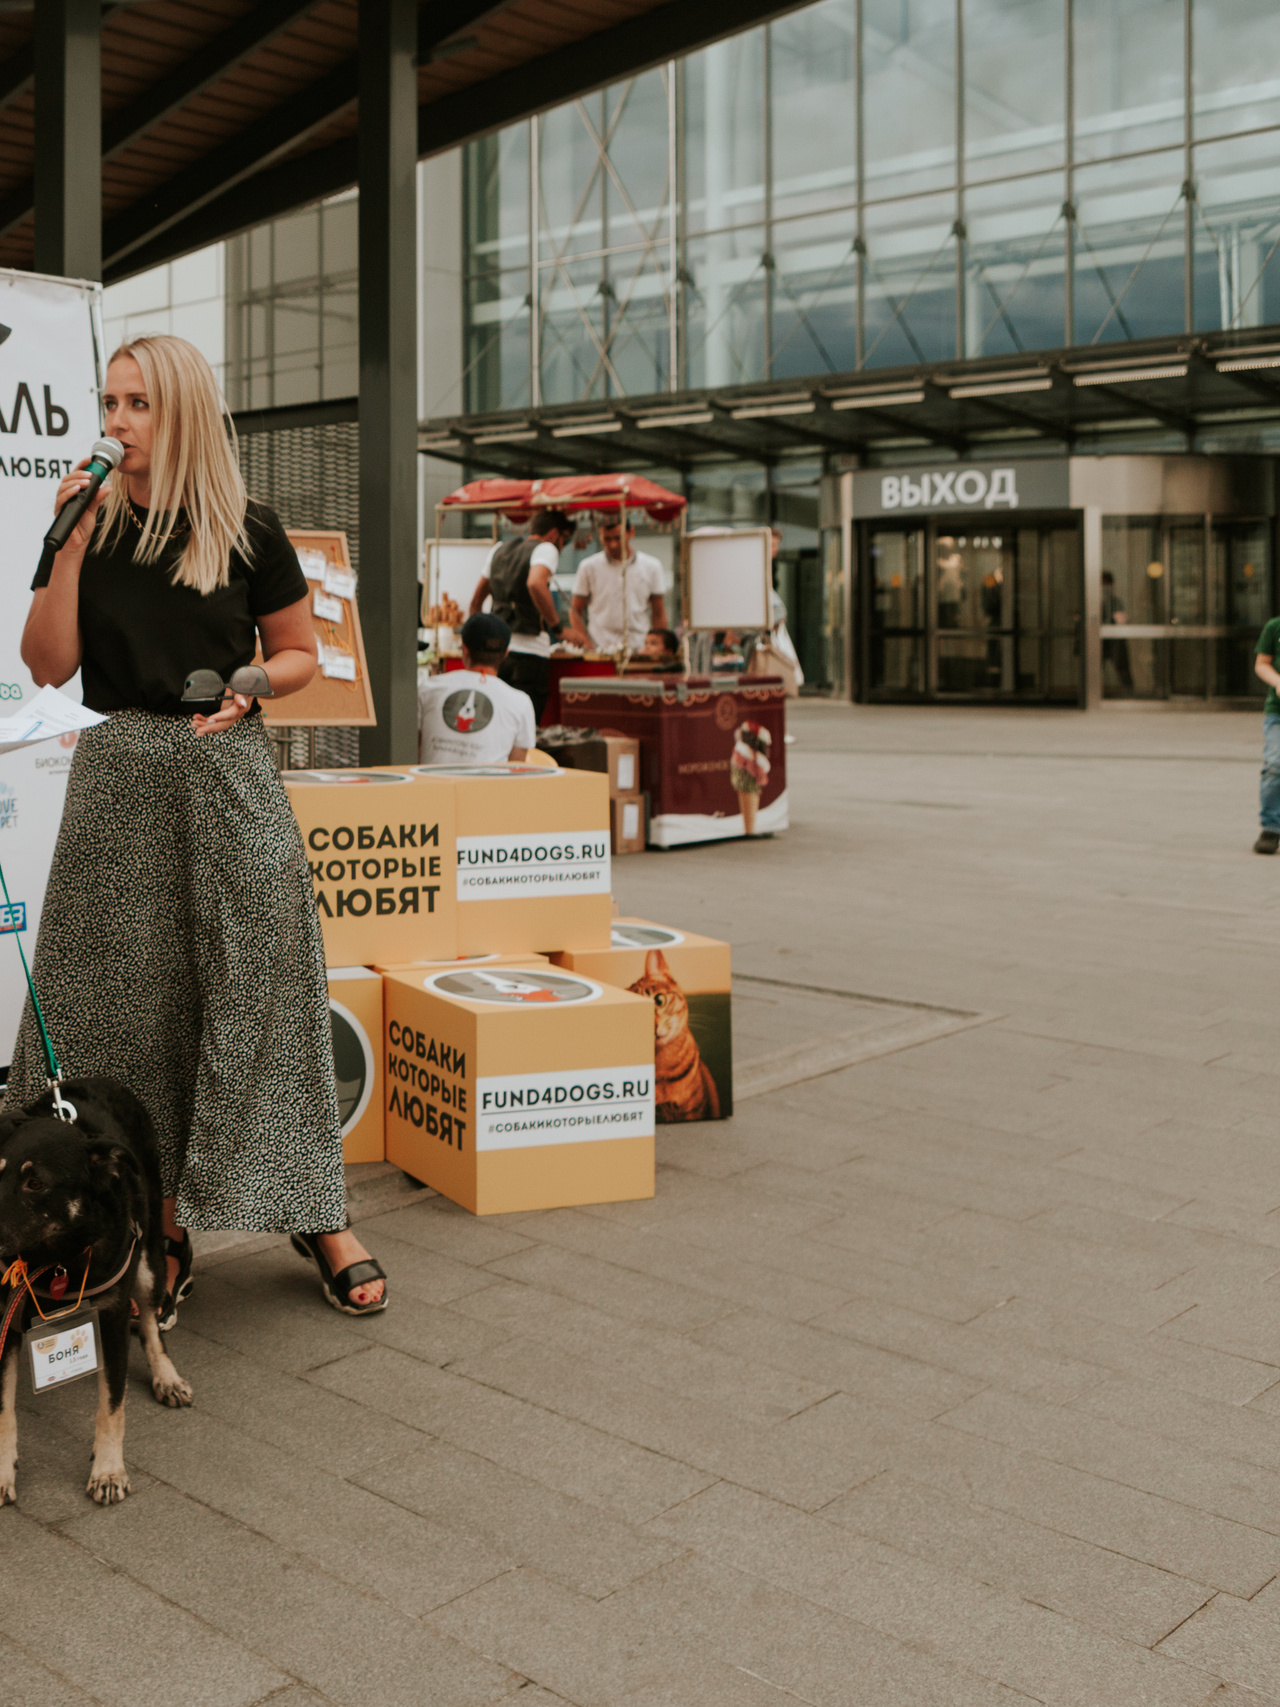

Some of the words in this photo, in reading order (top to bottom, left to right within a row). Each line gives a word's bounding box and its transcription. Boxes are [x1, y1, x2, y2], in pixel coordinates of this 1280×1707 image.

[881, 468, 1019, 509] ВЫХОД
[308, 823, 439, 851] СОБАКИ
[457, 843, 605, 865] FUND4DOGS.RU
[308, 856, 441, 882] КОТОРЫЕ
[463, 871, 601, 887] #СОБАКИКОТОРЫЕЛЮБЯТ
[317, 886, 440, 918] ЛЮБЯТ
[389, 1020, 466, 1079] СОБАКИ
[389, 1052, 467, 1113] КОТОРЫЕ
[482, 1080, 649, 1109] FUND4DOGS.RU
[389, 1085, 466, 1151] ЛЮБЯТ
[488, 1111, 644, 1133] #СОБАКИКОТОРЫЕЛЮБЯТ
[48, 1344, 79, 1365] БОНЯ
